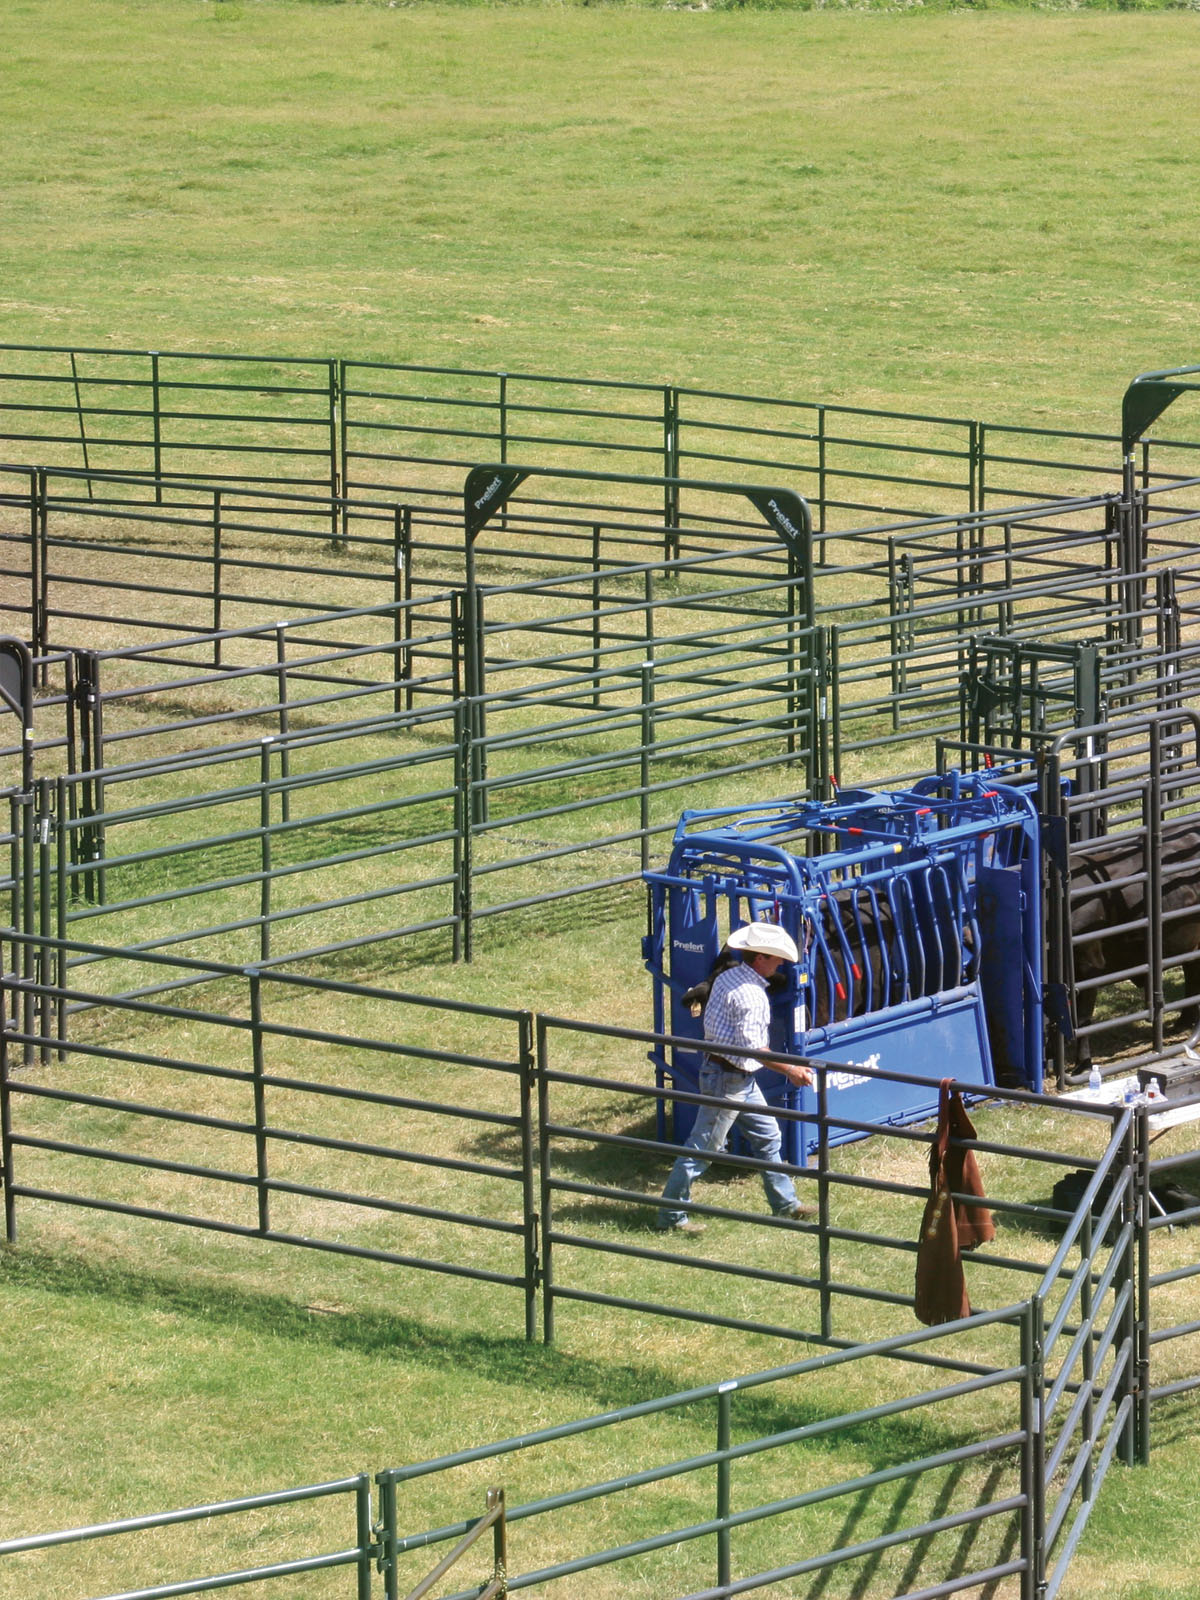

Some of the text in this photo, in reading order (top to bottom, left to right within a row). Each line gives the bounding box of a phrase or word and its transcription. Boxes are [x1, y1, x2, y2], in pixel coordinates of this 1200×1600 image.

[473, 474, 500, 510] Priefert
[768, 499, 799, 537] Priefert
[673, 939, 705, 951] Priefert
